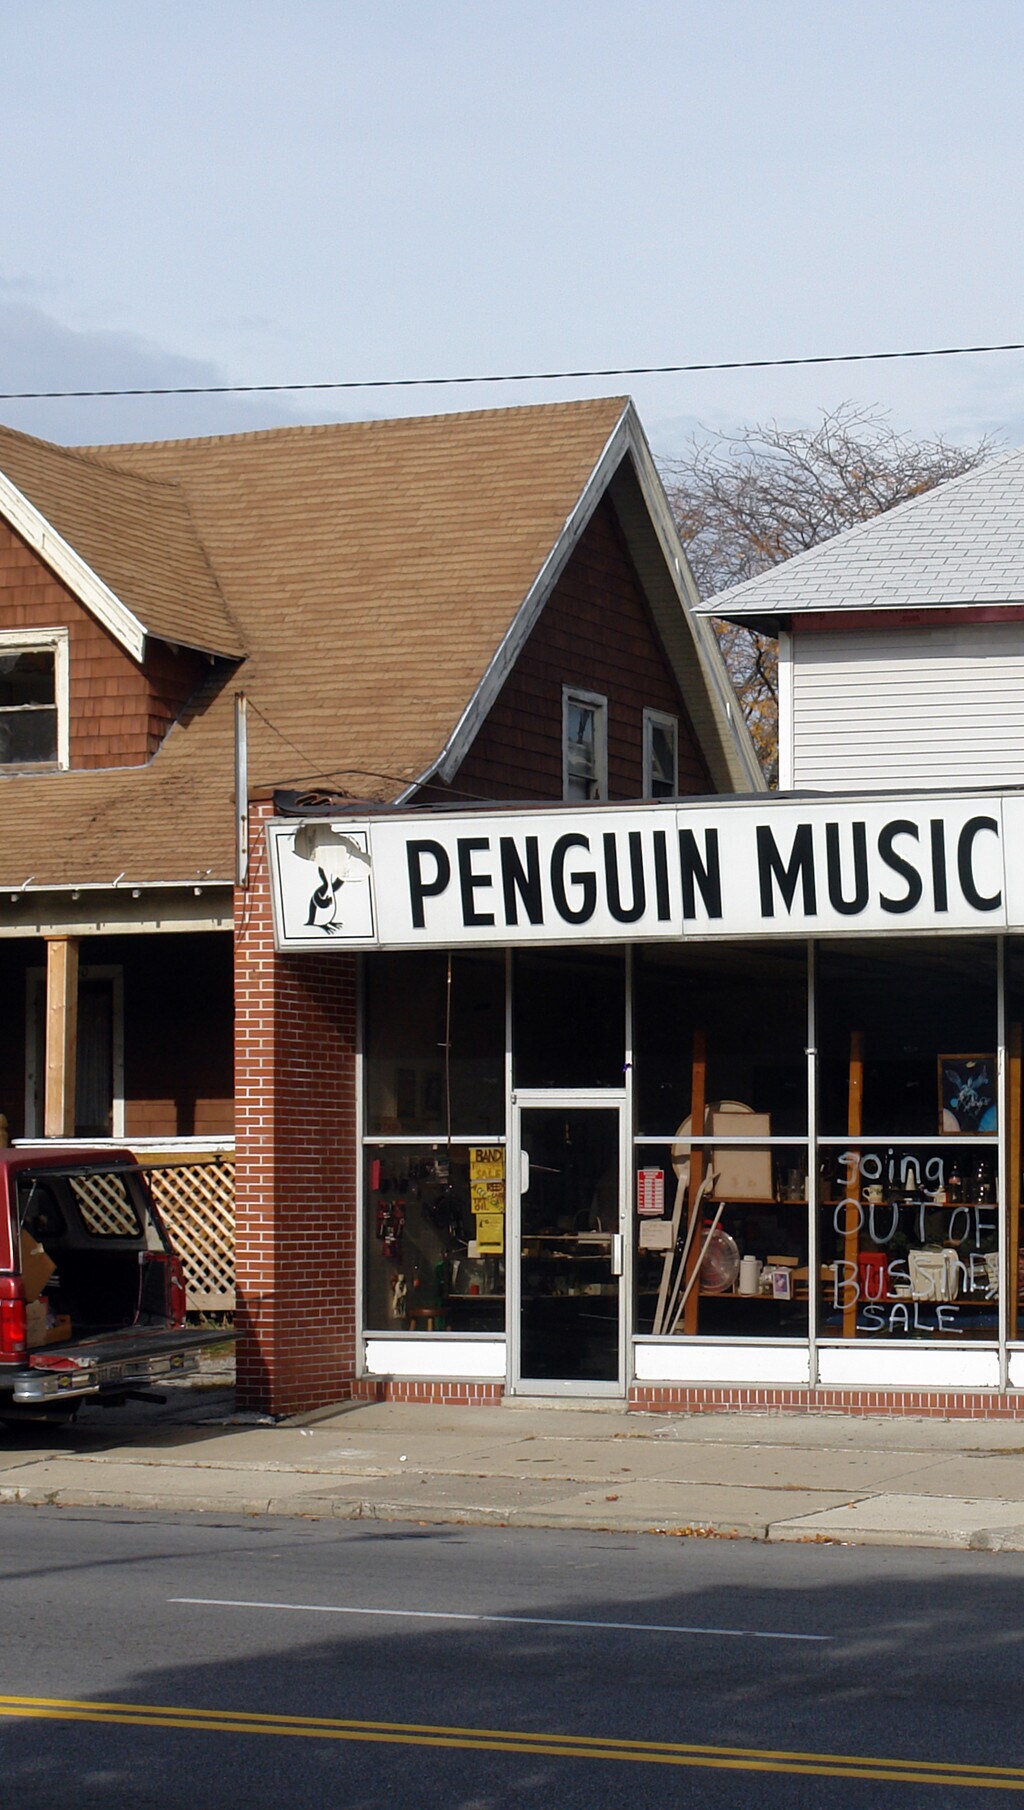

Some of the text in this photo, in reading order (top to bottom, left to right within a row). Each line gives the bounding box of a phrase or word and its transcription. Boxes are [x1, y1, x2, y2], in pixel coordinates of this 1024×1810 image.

[406, 828, 723, 928] PENGUIN
[756, 816, 1002, 920] MUSIC
[475, 1148, 503, 1163] BAND
[834, 1198, 996, 1249] OUT OF
[856, 1302, 964, 1333] SALE
